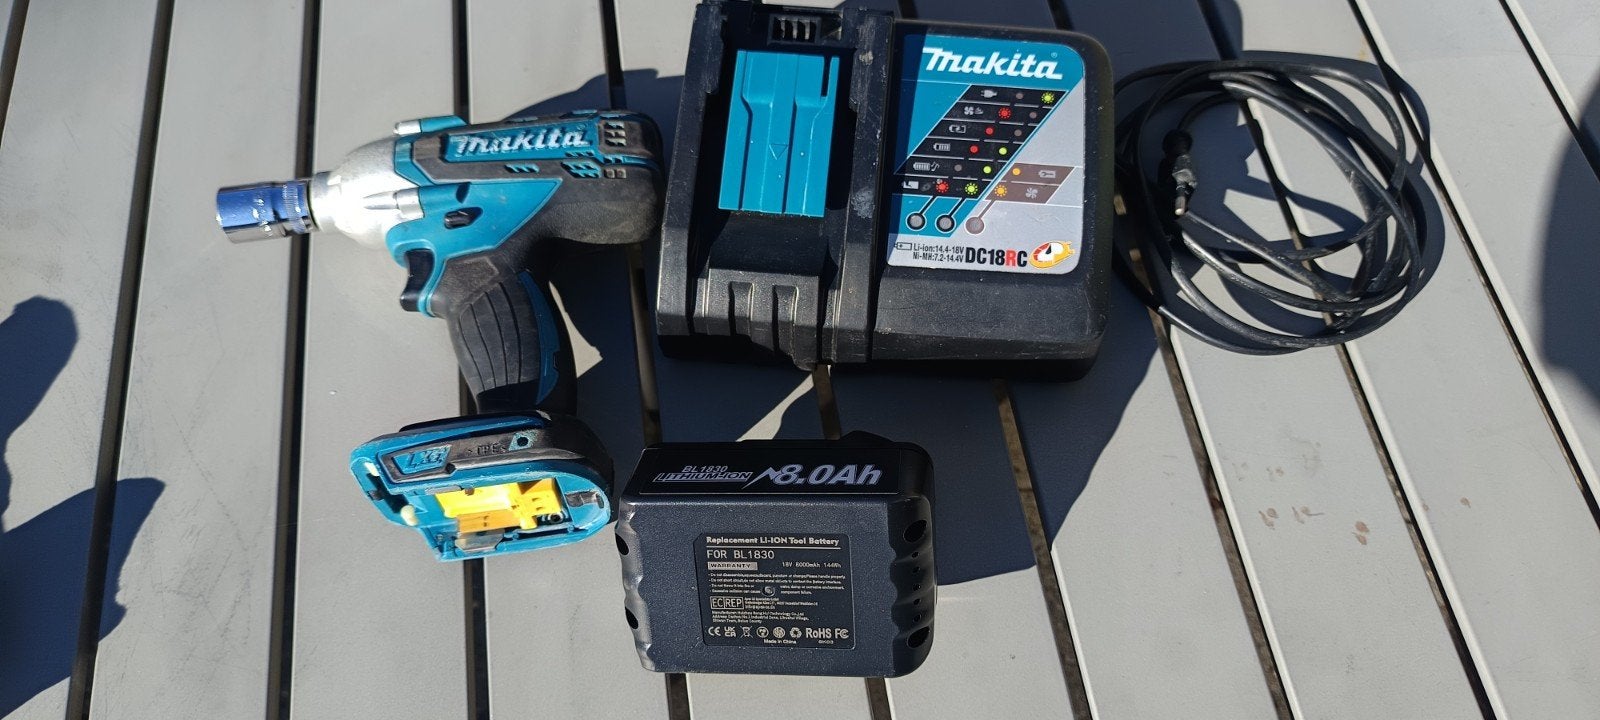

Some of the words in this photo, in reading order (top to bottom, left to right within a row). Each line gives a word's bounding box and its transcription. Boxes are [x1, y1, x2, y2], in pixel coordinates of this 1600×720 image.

[965, 247, 1028, 267] DC18RC
[682, 465, 728, 473] BL1830
[773, 464, 883, 485] 8.0Ah
[706, 536, 758, 545] Replacement
[788, 537, 807, 545] Tool
[808, 537, 840, 547] Battery
[706, 549, 727, 559] FOR
[733, 549, 775, 560] BL1830
[712, 598, 723, 608] EC
[725, 598, 742, 608] REP
[805, 627, 832, 639] RoHS
